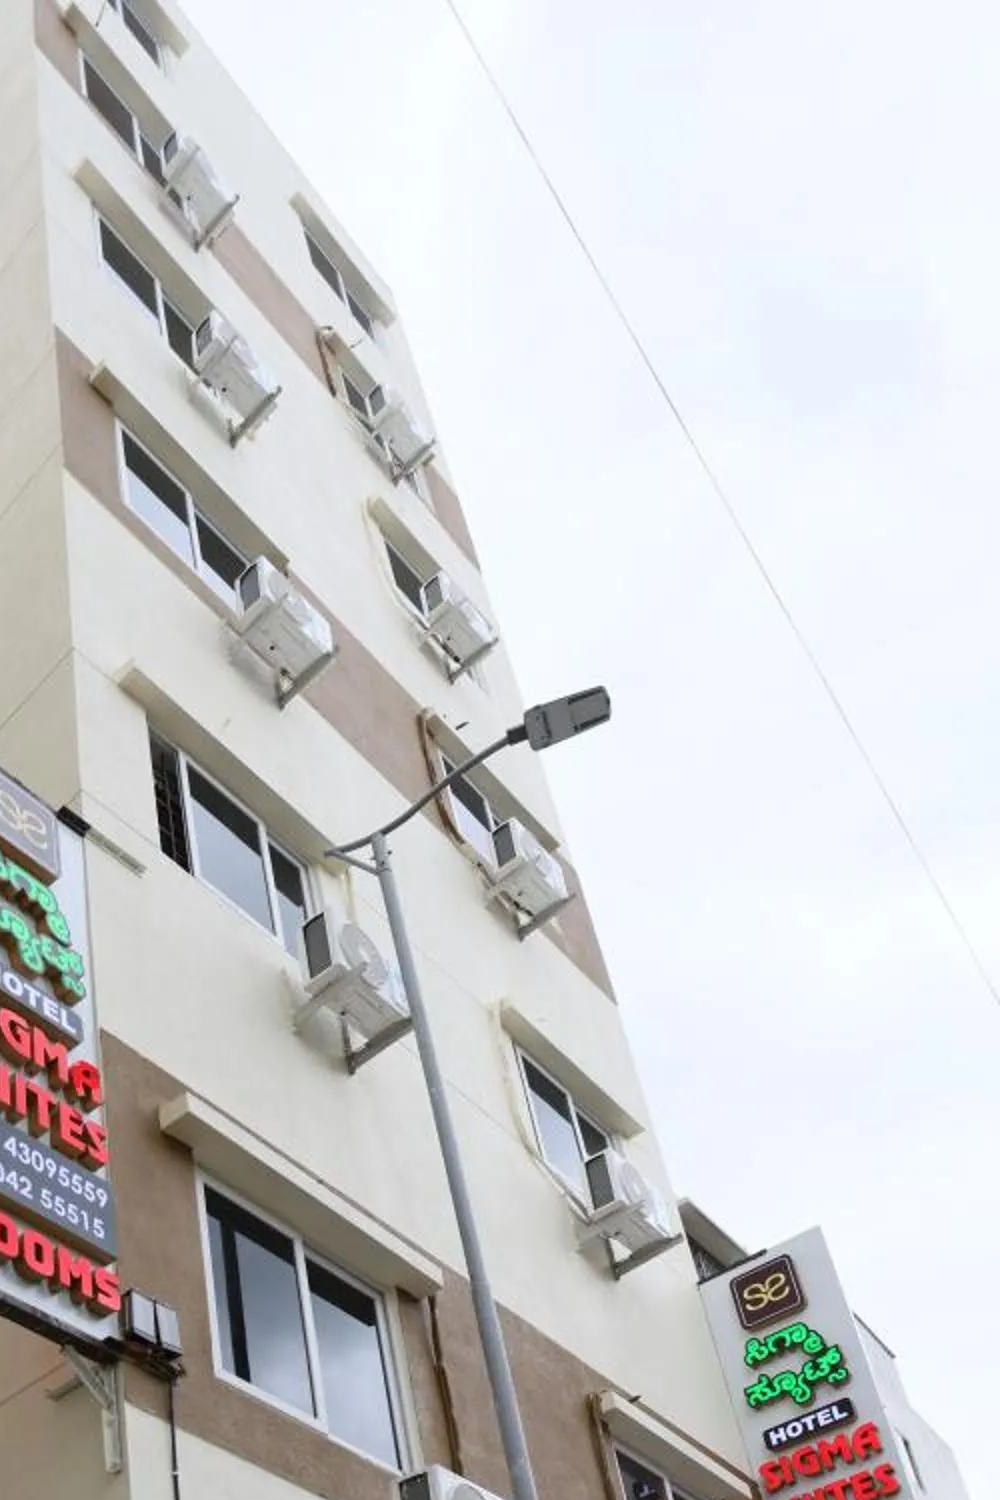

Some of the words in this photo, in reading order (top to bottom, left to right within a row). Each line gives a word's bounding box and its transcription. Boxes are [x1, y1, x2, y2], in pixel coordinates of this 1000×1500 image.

[3, 1136, 109, 1209] 43095559
[39, 1188, 106, 1240] 55515
[769, 1405, 849, 1446] HOTEL
[758, 1420, 882, 1494] SIGMA
